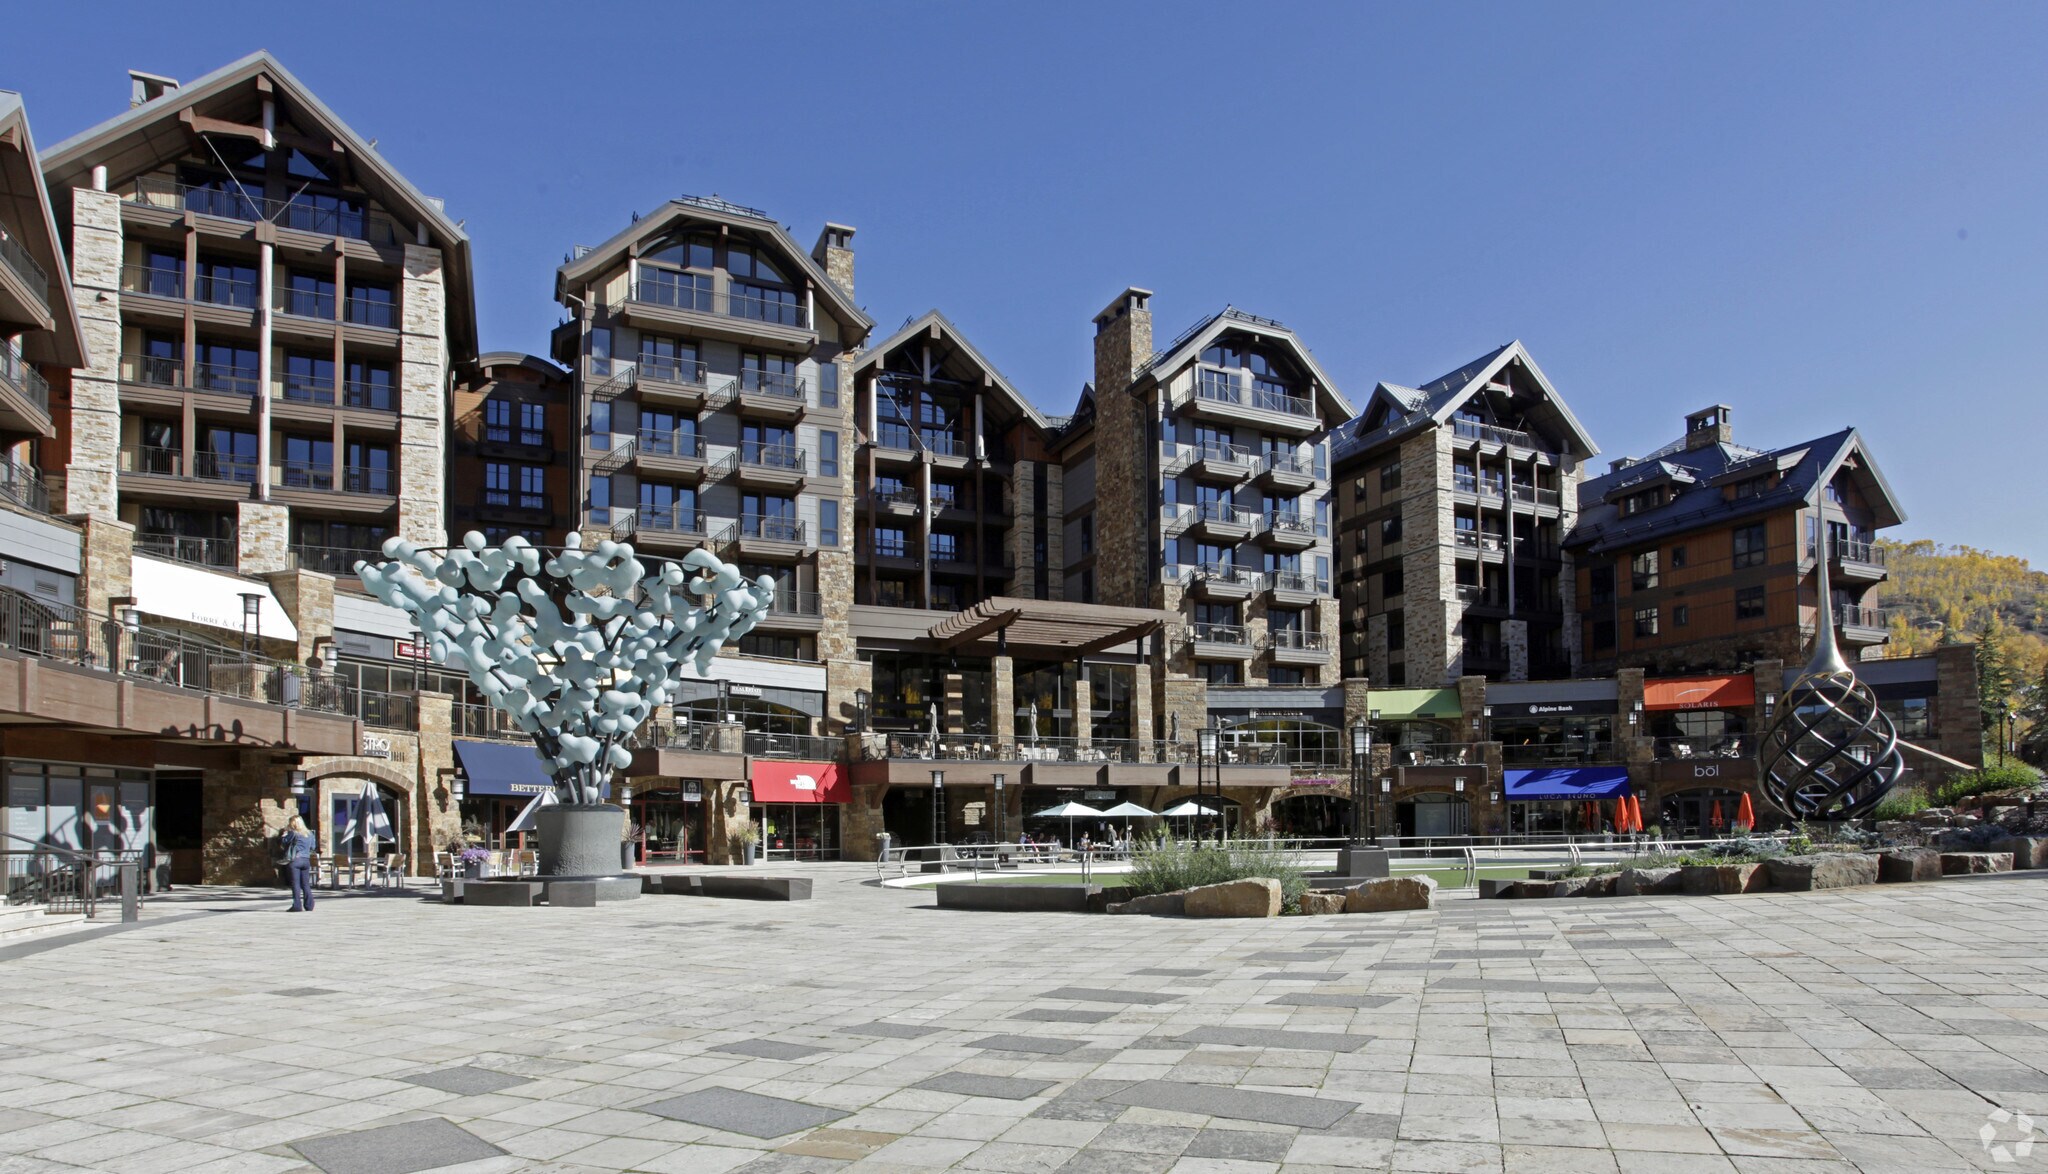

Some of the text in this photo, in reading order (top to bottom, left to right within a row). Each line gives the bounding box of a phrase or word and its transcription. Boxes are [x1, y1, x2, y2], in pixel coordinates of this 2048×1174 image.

[1538, 705, 1557, 713] Alpine
[1679, 701, 1719, 709] SOLARIS
[363, 736, 391, 751] STRO
